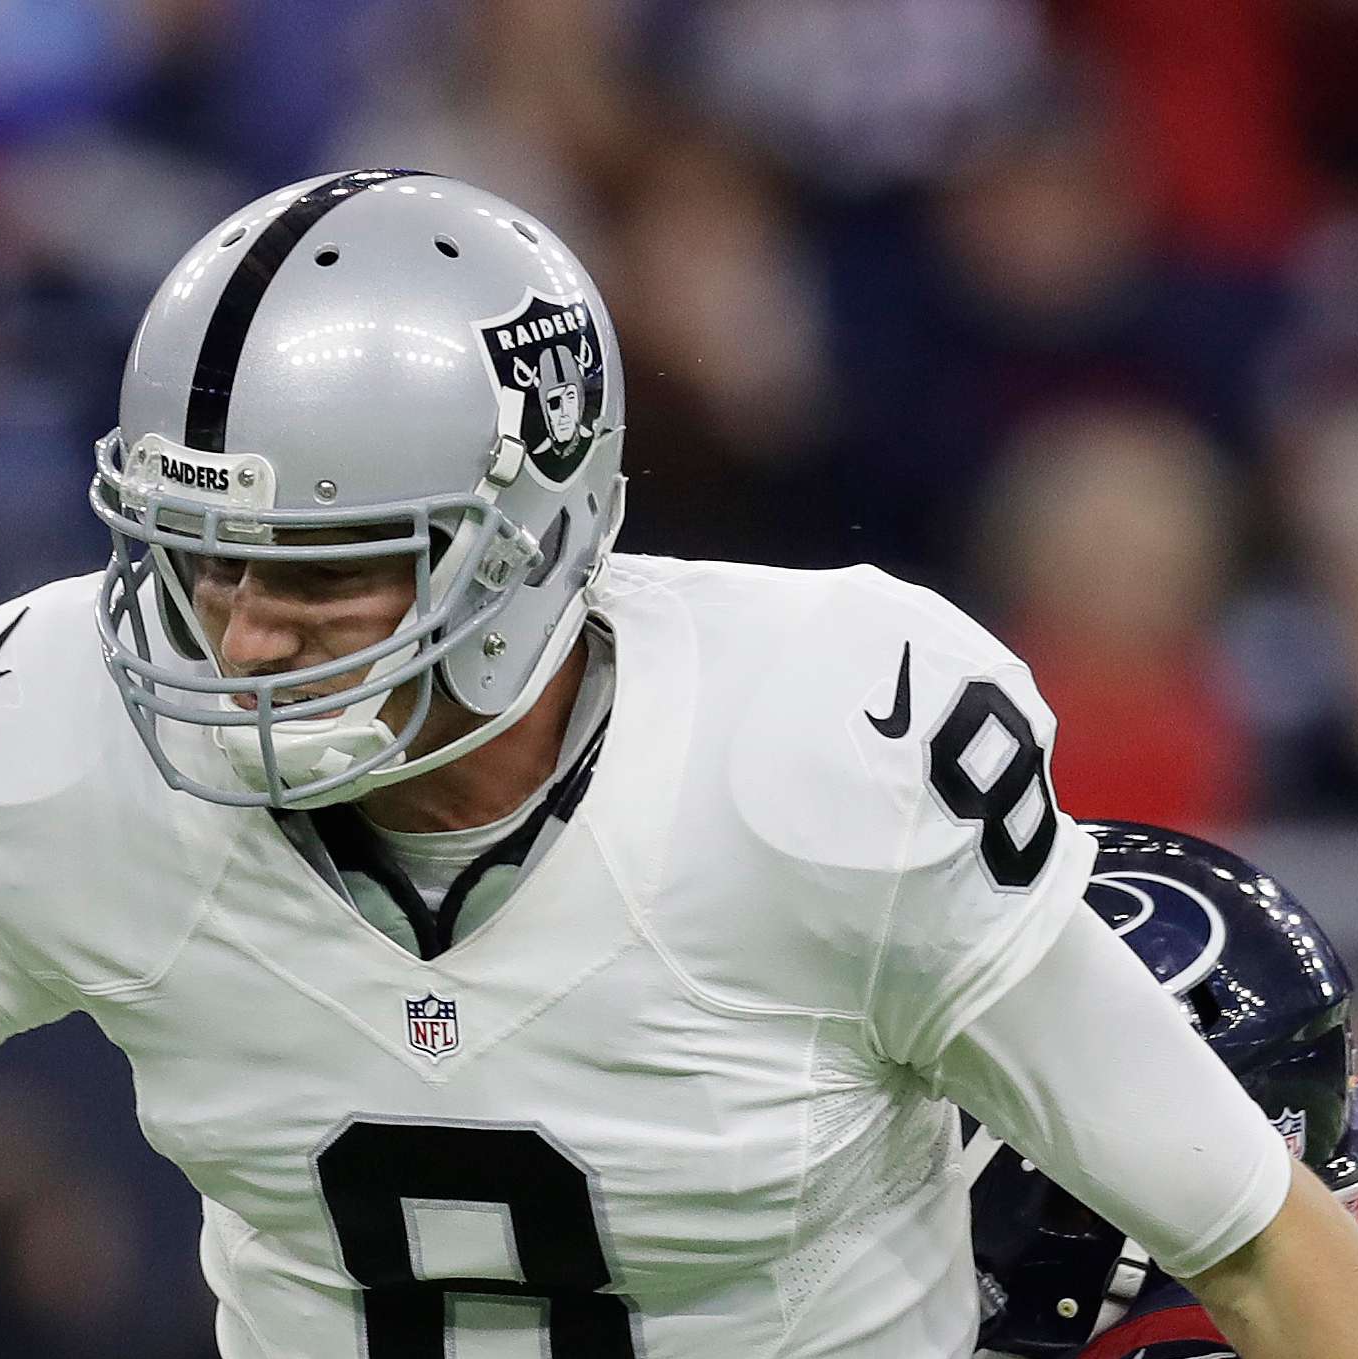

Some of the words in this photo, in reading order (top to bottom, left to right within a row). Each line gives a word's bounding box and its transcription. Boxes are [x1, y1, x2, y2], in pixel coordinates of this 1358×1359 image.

[496, 303, 587, 350] RAIDERS
[161, 453, 230, 491] RAIDERS
[921, 676, 1059, 893] 8
[412, 1021, 454, 1050] NFL
